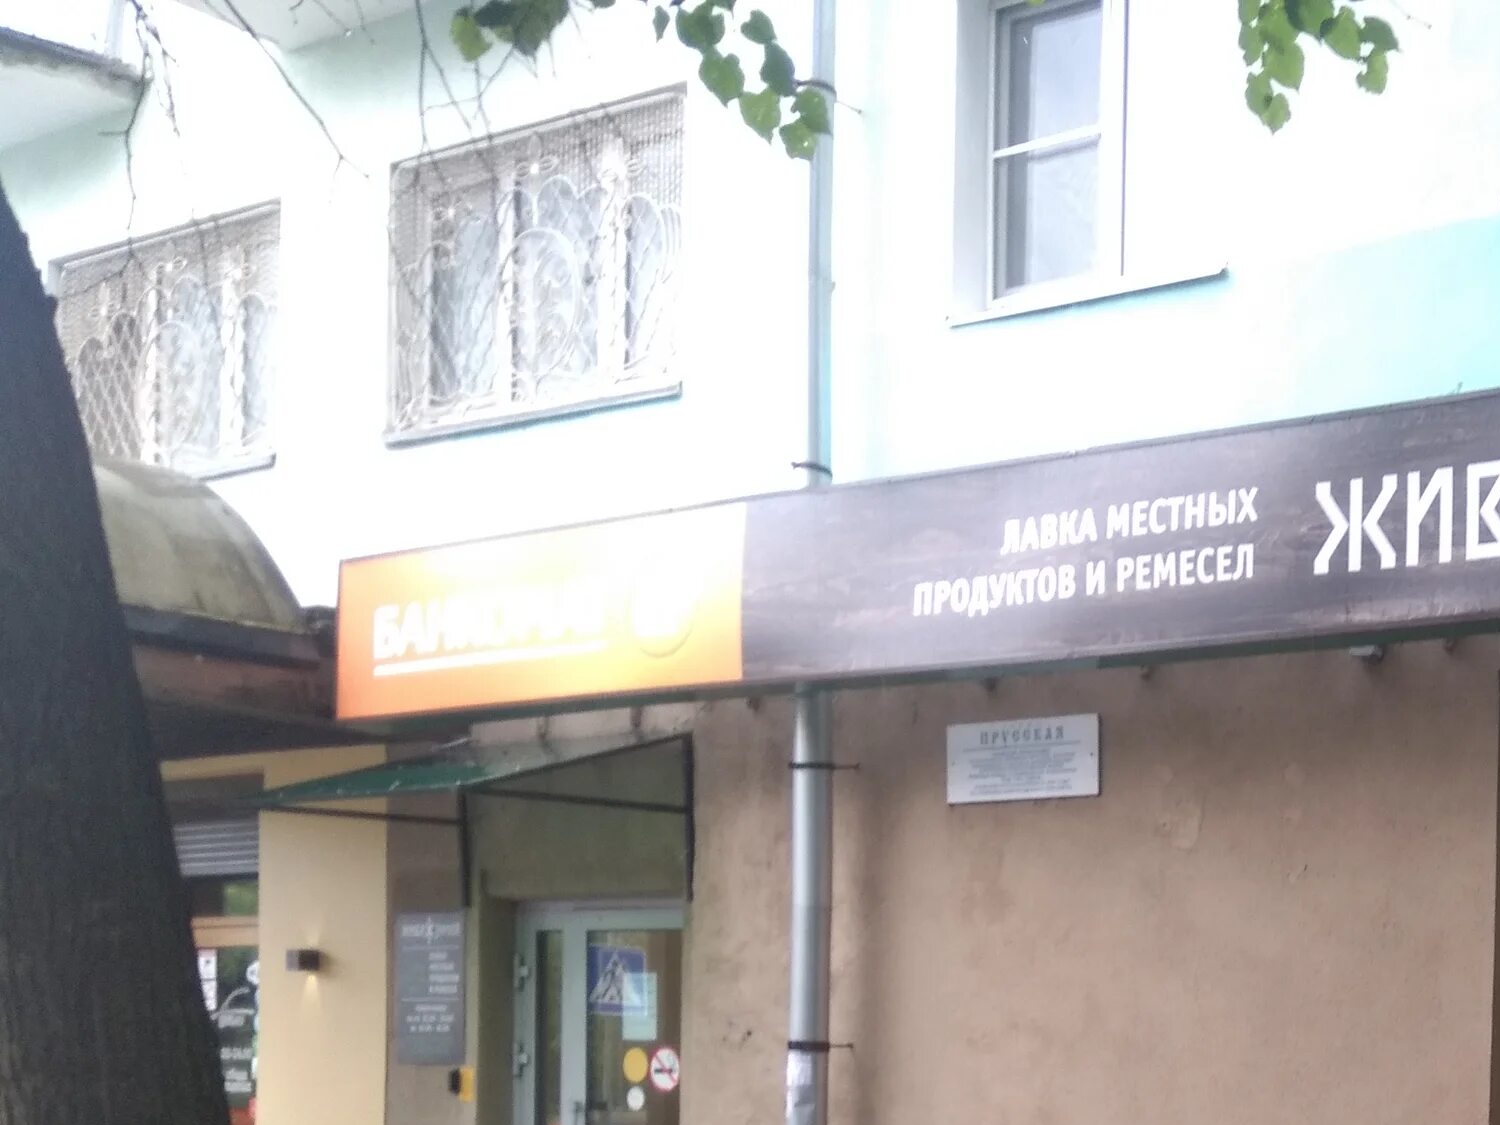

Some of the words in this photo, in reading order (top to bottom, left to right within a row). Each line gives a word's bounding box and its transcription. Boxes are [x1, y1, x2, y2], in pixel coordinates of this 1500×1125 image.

[1000, 507, 1098, 555] ЛАВКА
[1105, 486, 1259, 540] МЕСТНЫХ
[912, 561, 1076, 618] ПРОДУКТОВ
[1085, 560, 1106, 597] И
[1116, 544, 1255, 593] РЕМЕСЕЛ
[979, 725, 1065, 747] ПРУССКАЯ
